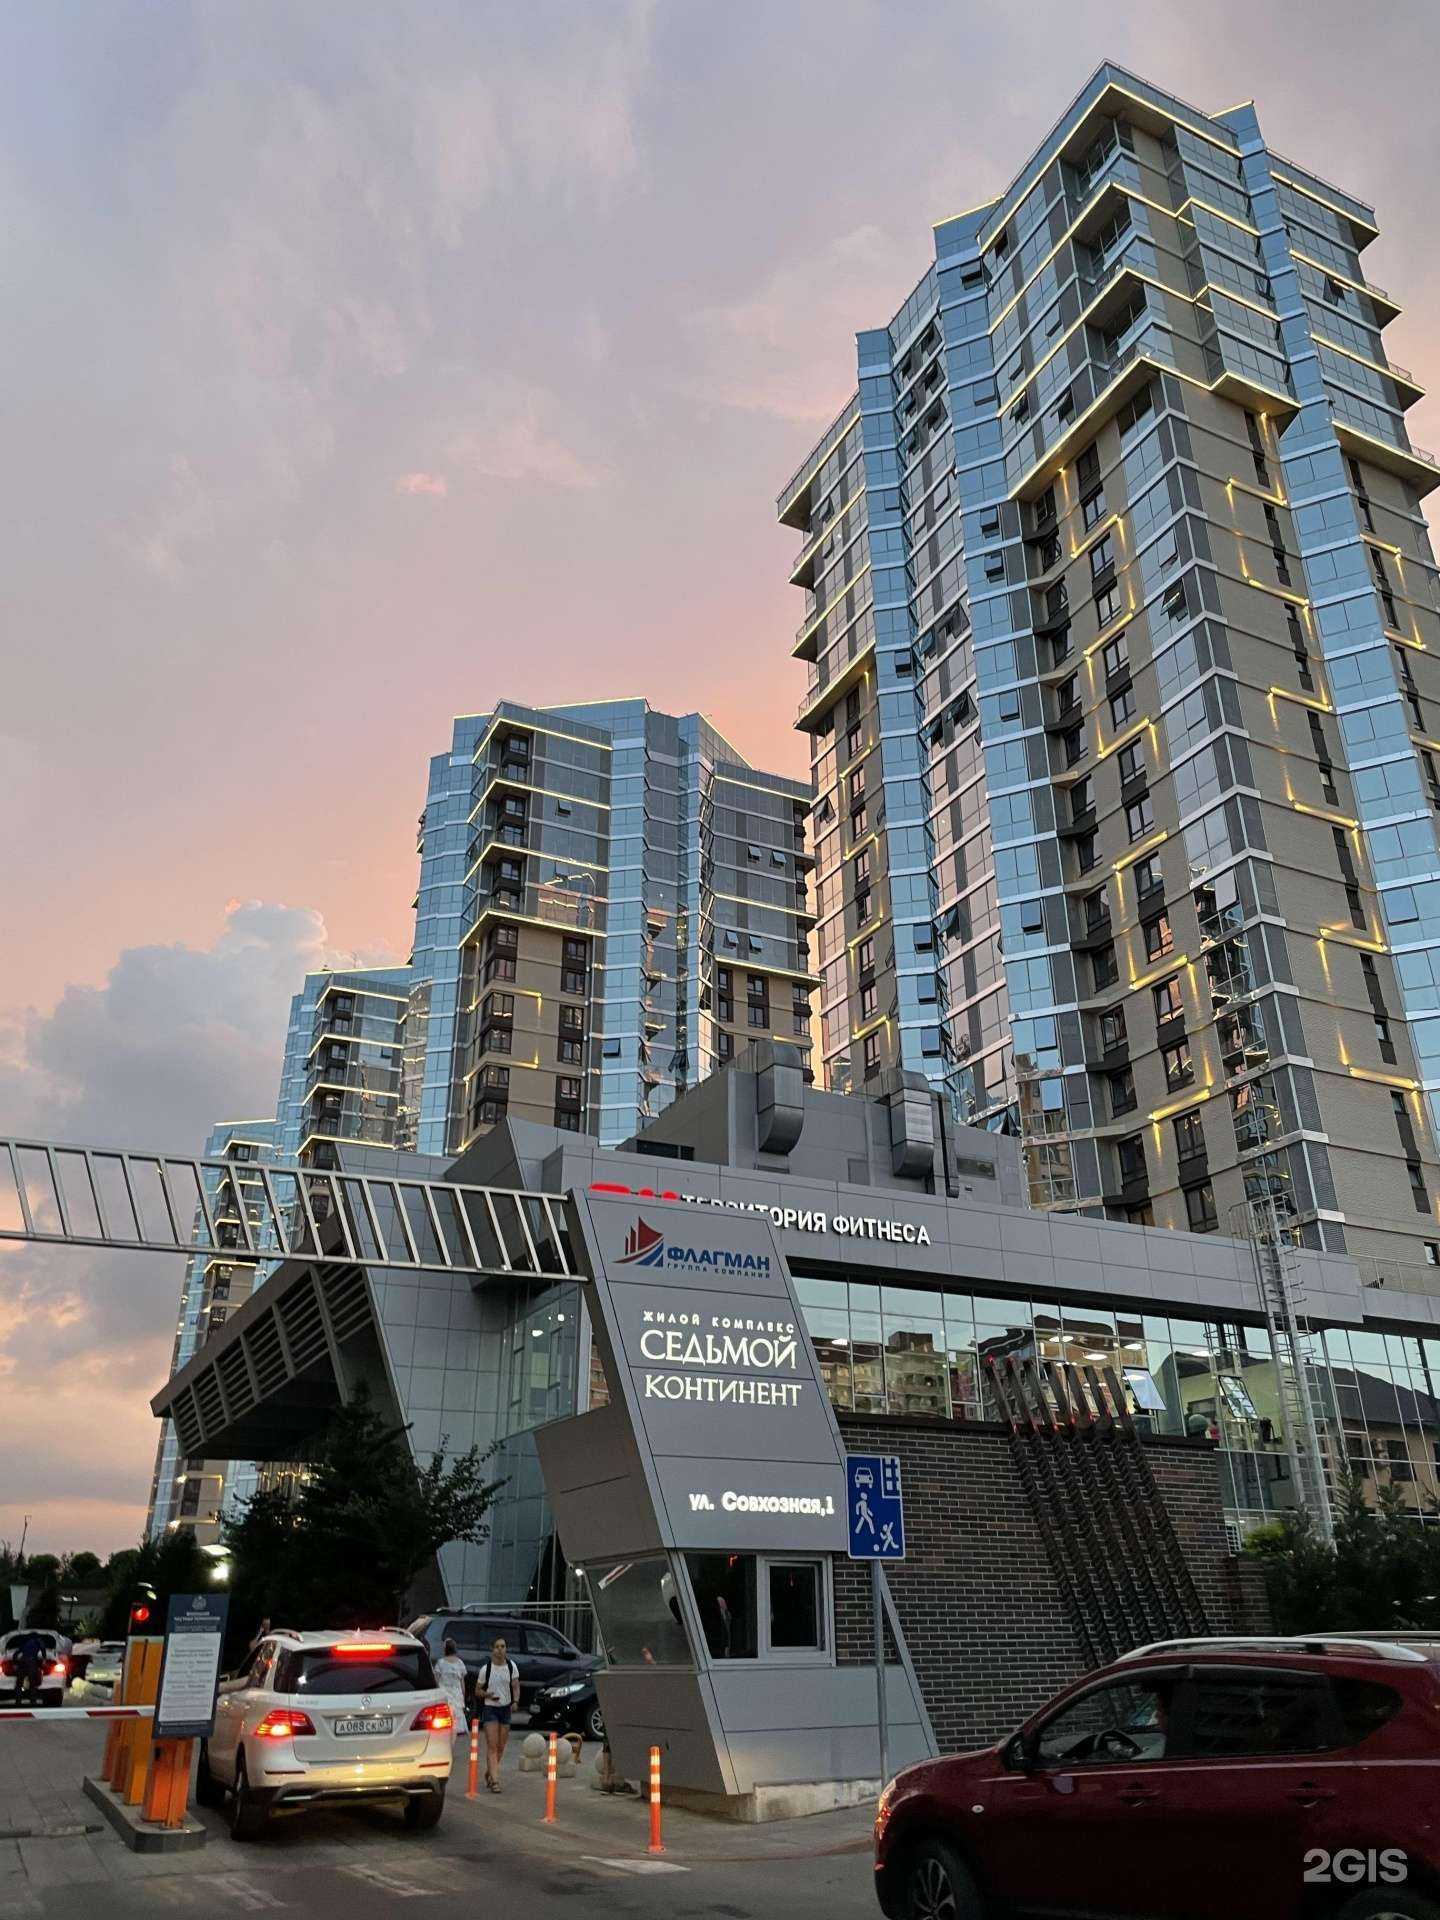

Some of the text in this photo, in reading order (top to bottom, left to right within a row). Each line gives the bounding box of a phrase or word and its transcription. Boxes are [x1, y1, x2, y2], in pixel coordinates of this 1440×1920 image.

[681, 1194, 931, 1246] ТТОРИЯ ФИТНЕСА
[667, 1247, 770, 1271] ФЛАГМАН
[667, 1262, 770, 1279] ГРУППА КОМПАНИЙ
[643, 1310, 795, 1334] ЖИЛОЙ КОМПЛЕКС
[640, 1329, 798, 1370] СЕДЬМОЙ
[644, 1374, 802, 1407] КОНТИНЕНТ
[688, 1491, 835, 1517] ул. Совхозная,1
